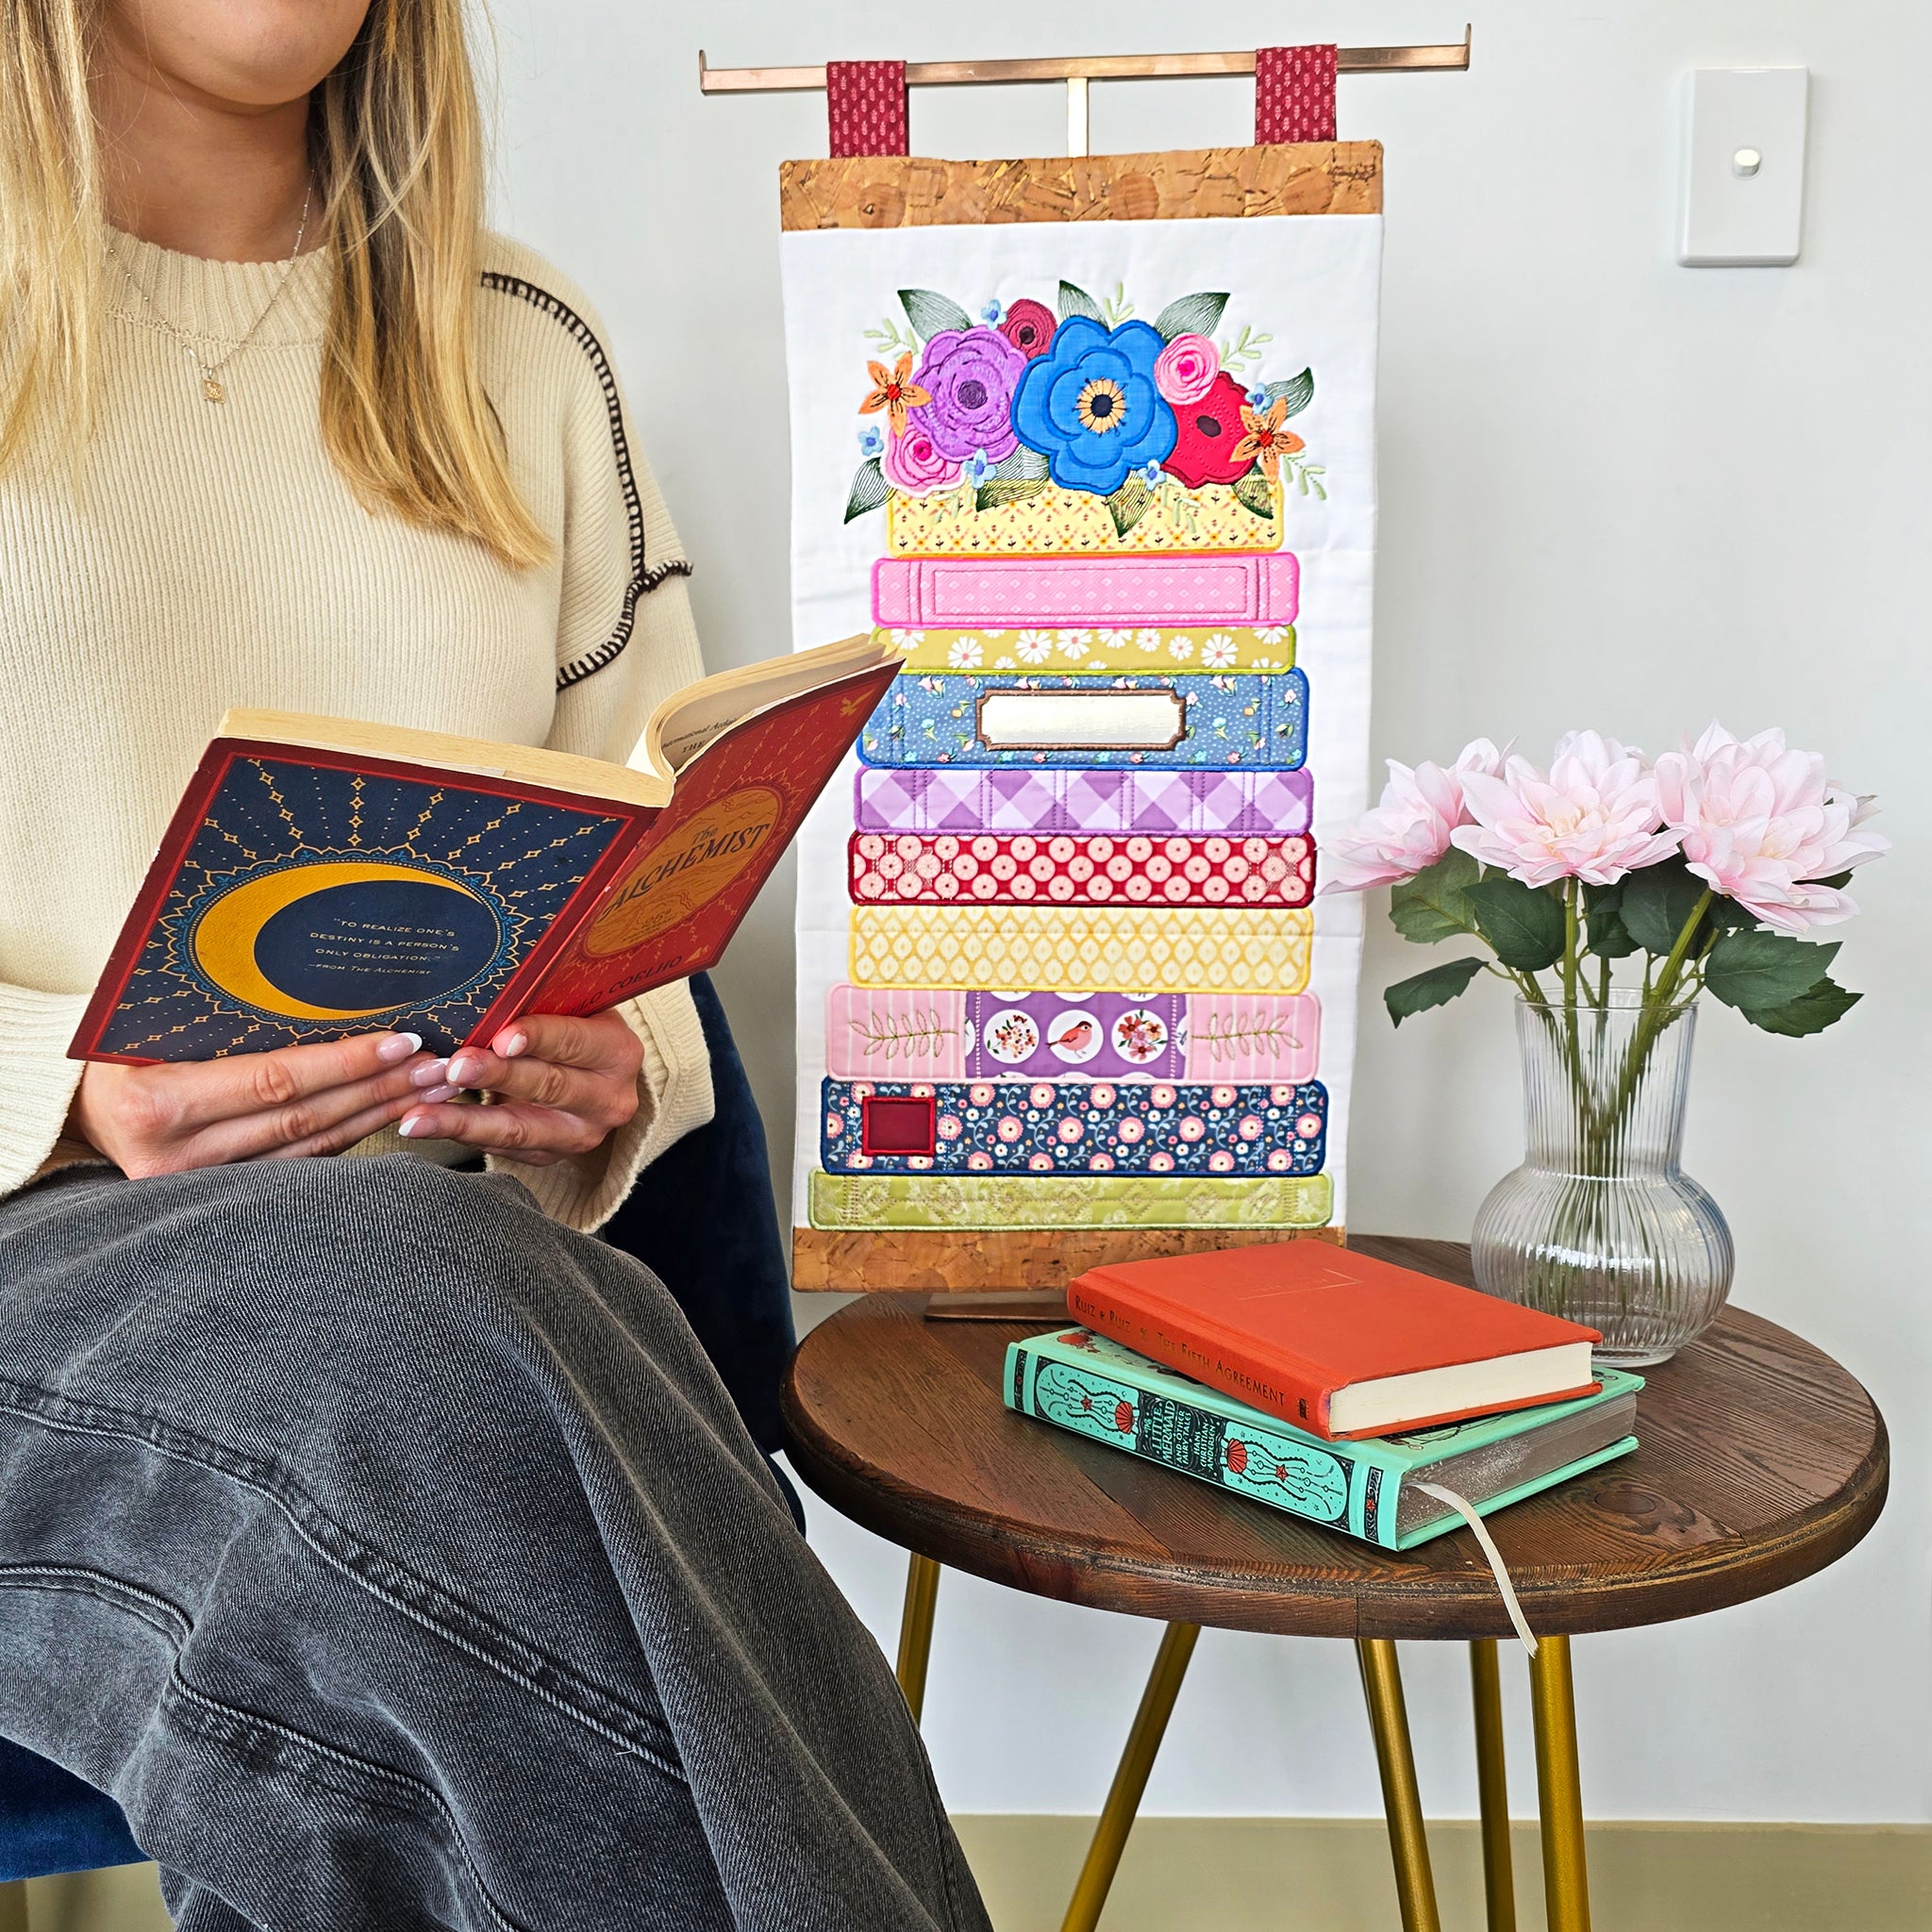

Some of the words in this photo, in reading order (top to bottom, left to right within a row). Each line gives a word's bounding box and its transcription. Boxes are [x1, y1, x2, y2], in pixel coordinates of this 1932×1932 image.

[692, 826, 719, 844] The
[596, 824, 771, 924] ALCHEMIST
[309, 932, 365, 943] DESTINY
[397, 941, 459, 952] PERSON'S
[361, 924, 412, 933] REALIZE
[416, 928, 455, 937] ONE'S
[315, 948, 349, 957] ONLY
[608, 956, 683, 993] COELHO
[1075, 1294, 1096, 1318] RUIZ
[1109, 1309, 1131, 1333] RUIZ
[1181, 1342, 1210, 1367] FIFTH
[1215, 1359, 1285, 1406] AGREEMENT
[1152, 1407, 1164, 1450] LITTLE
[1162, 1400, 1175, 1464] MERMAID
[1176, 1410, 1185, 1441] OTHER
[1183, 1412, 1191, 1436] TALES
[1193, 1431, 1202, 1455] HANS
[1200, 1423, 1208, 1467] CHRISTIAN
[1208, 1425, 1216, 1470] ANDERSEN
